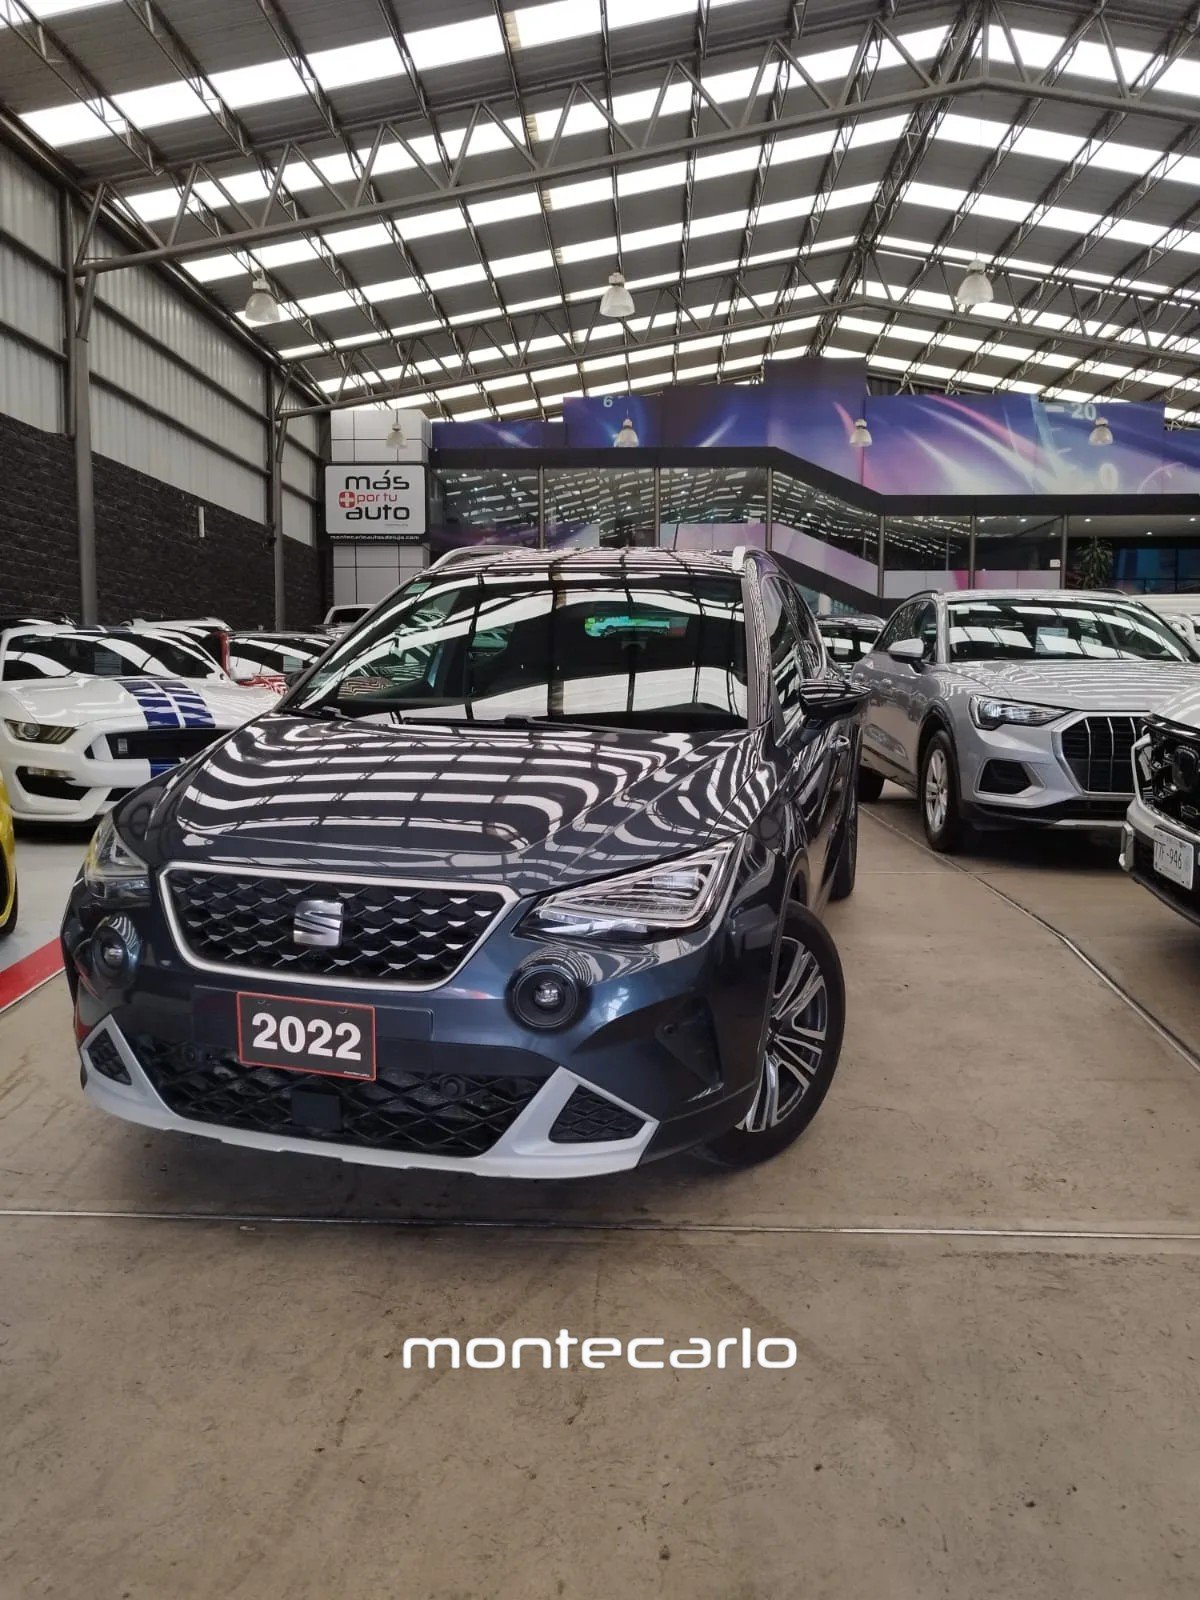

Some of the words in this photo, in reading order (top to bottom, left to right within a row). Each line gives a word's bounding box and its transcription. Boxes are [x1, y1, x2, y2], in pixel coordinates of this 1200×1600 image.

[603, 396, 614, 408] 6
[1071, 402, 1097, 421] 20
[345, 469, 410, 490] más
[357, 493, 381, 504] por
[383, 492, 398, 503] tu
[345, 504, 410, 521] auto
[251, 1012, 362, 1061] 2022
